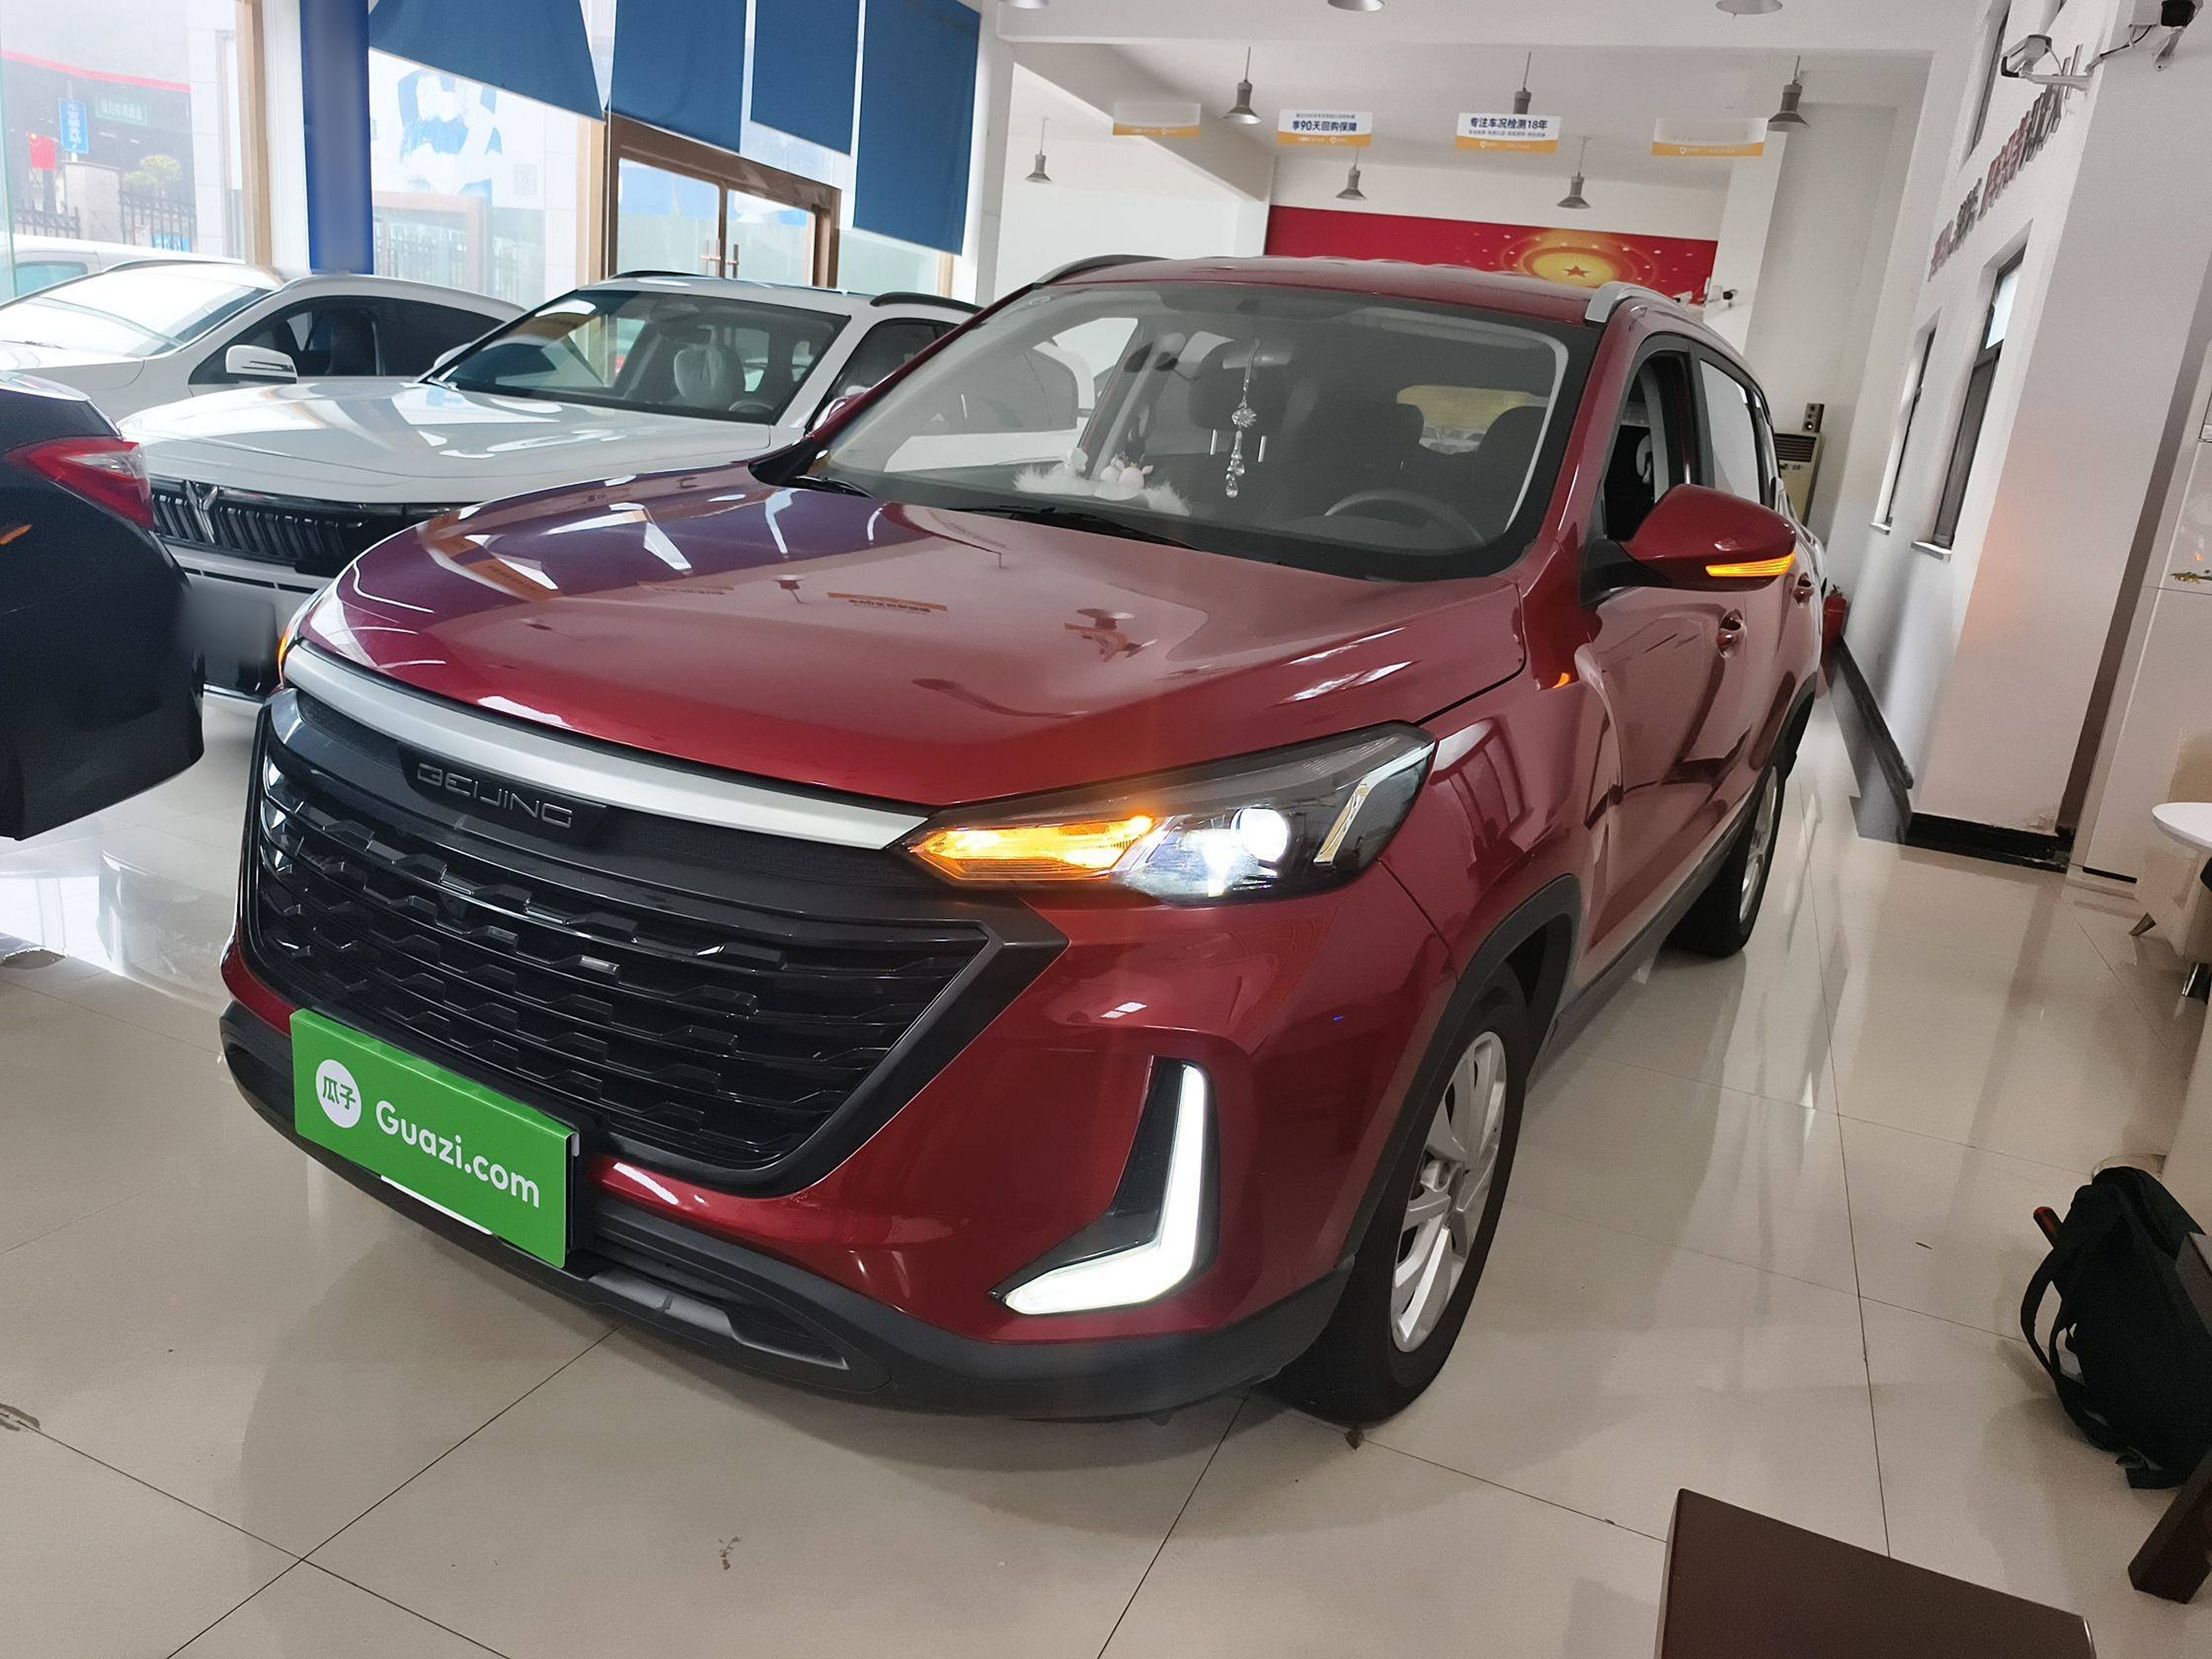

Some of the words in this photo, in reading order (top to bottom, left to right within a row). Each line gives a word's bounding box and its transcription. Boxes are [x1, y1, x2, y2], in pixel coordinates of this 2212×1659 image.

[1471, 117, 1548, 130] 专注车况检测18年
[417, 762, 573, 829] BEIJING
[322, 1075, 356, 1110] 瓜子
[376, 1100, 540, 1209] Guazi.com
